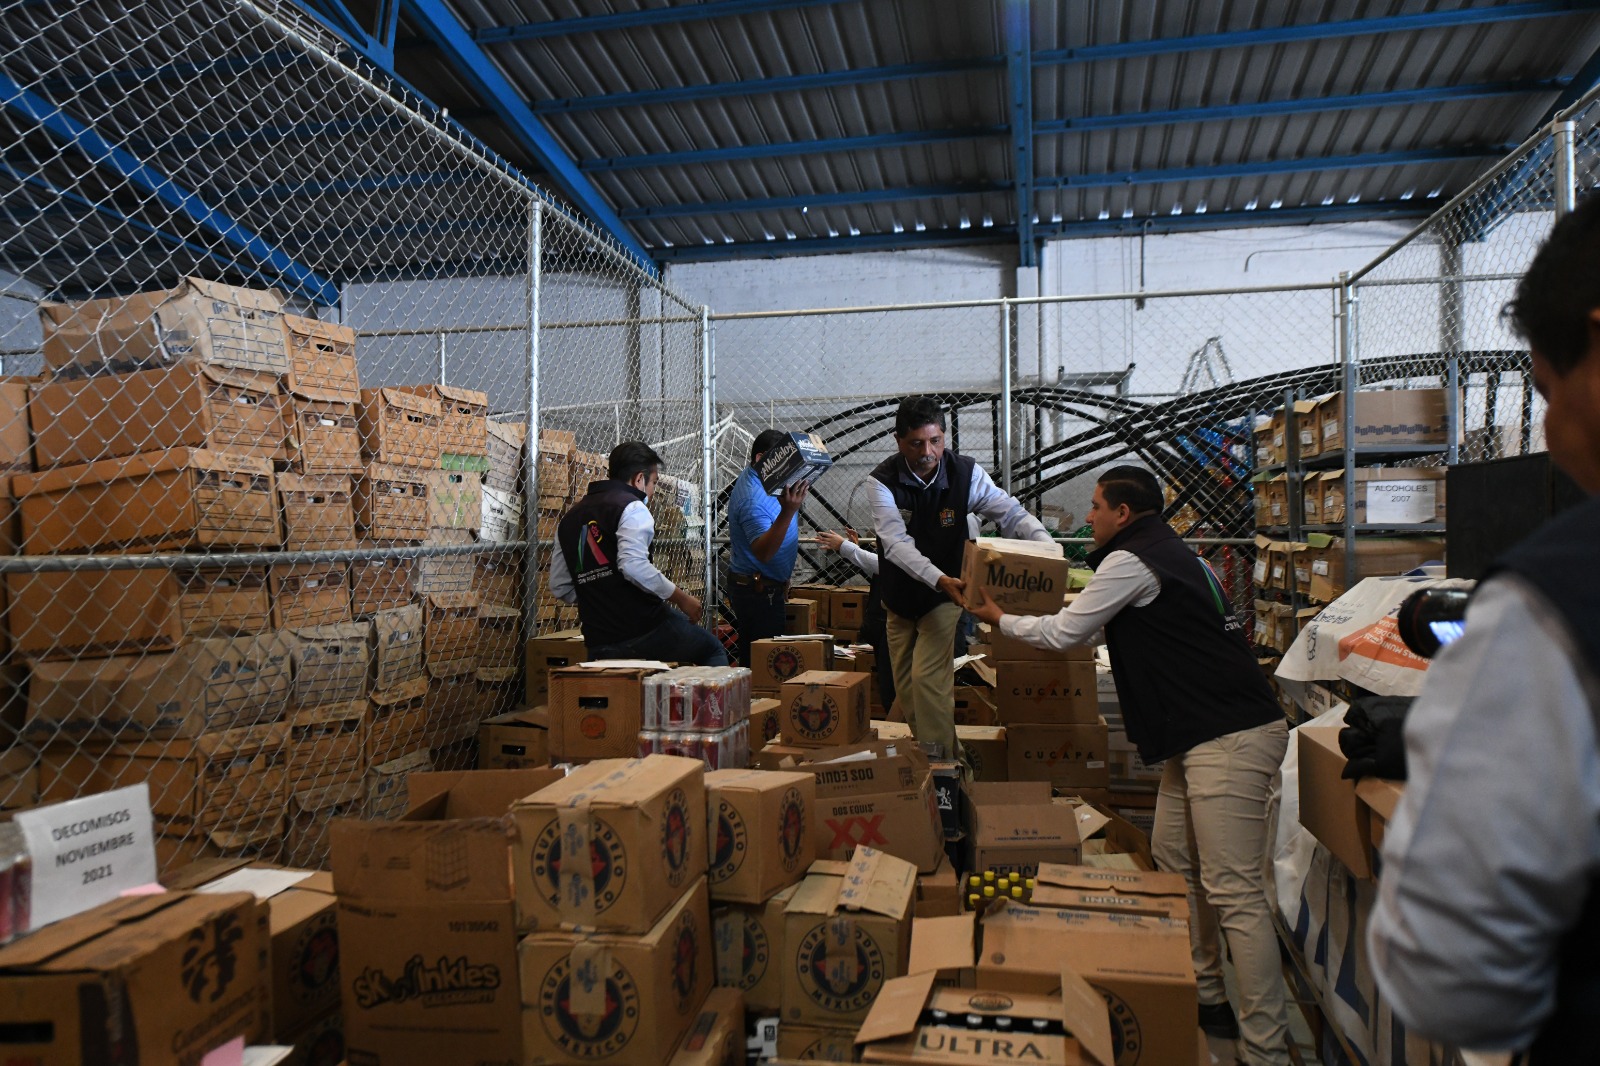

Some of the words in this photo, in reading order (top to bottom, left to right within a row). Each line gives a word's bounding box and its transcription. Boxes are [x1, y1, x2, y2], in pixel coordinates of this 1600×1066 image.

[1374, 484, 1428, 492] ALCOHOLES
[986, 563, 1054, 593] Modelo
[799, 727, 832, 739] MEXICO
[850, 766, 874, 780] DOS
[832, 806, 848, 816] DOS
[849, 803, 873, 815] EQUIS
[51, 808, 131, 841] DECOMISOS
[719, 802, 744, 851] ODELO
[824, 814, 890, 850] XX
[55, 832, 135, 867] NOVIEMBRE
[594, 821, 624, 877] ODELO
[82, 864, 113, 885] 2021
[1085, 895, 1135, 906] INDIO
[855, 929, 882, 980] ODELO
[614, 968, 637, 1018] DELO
[811, 988, 872, 1009] MEXICO
[558, 1032, 626, 1057] MEXICO
[920, 1032, 1044, 1060] ULTRA
